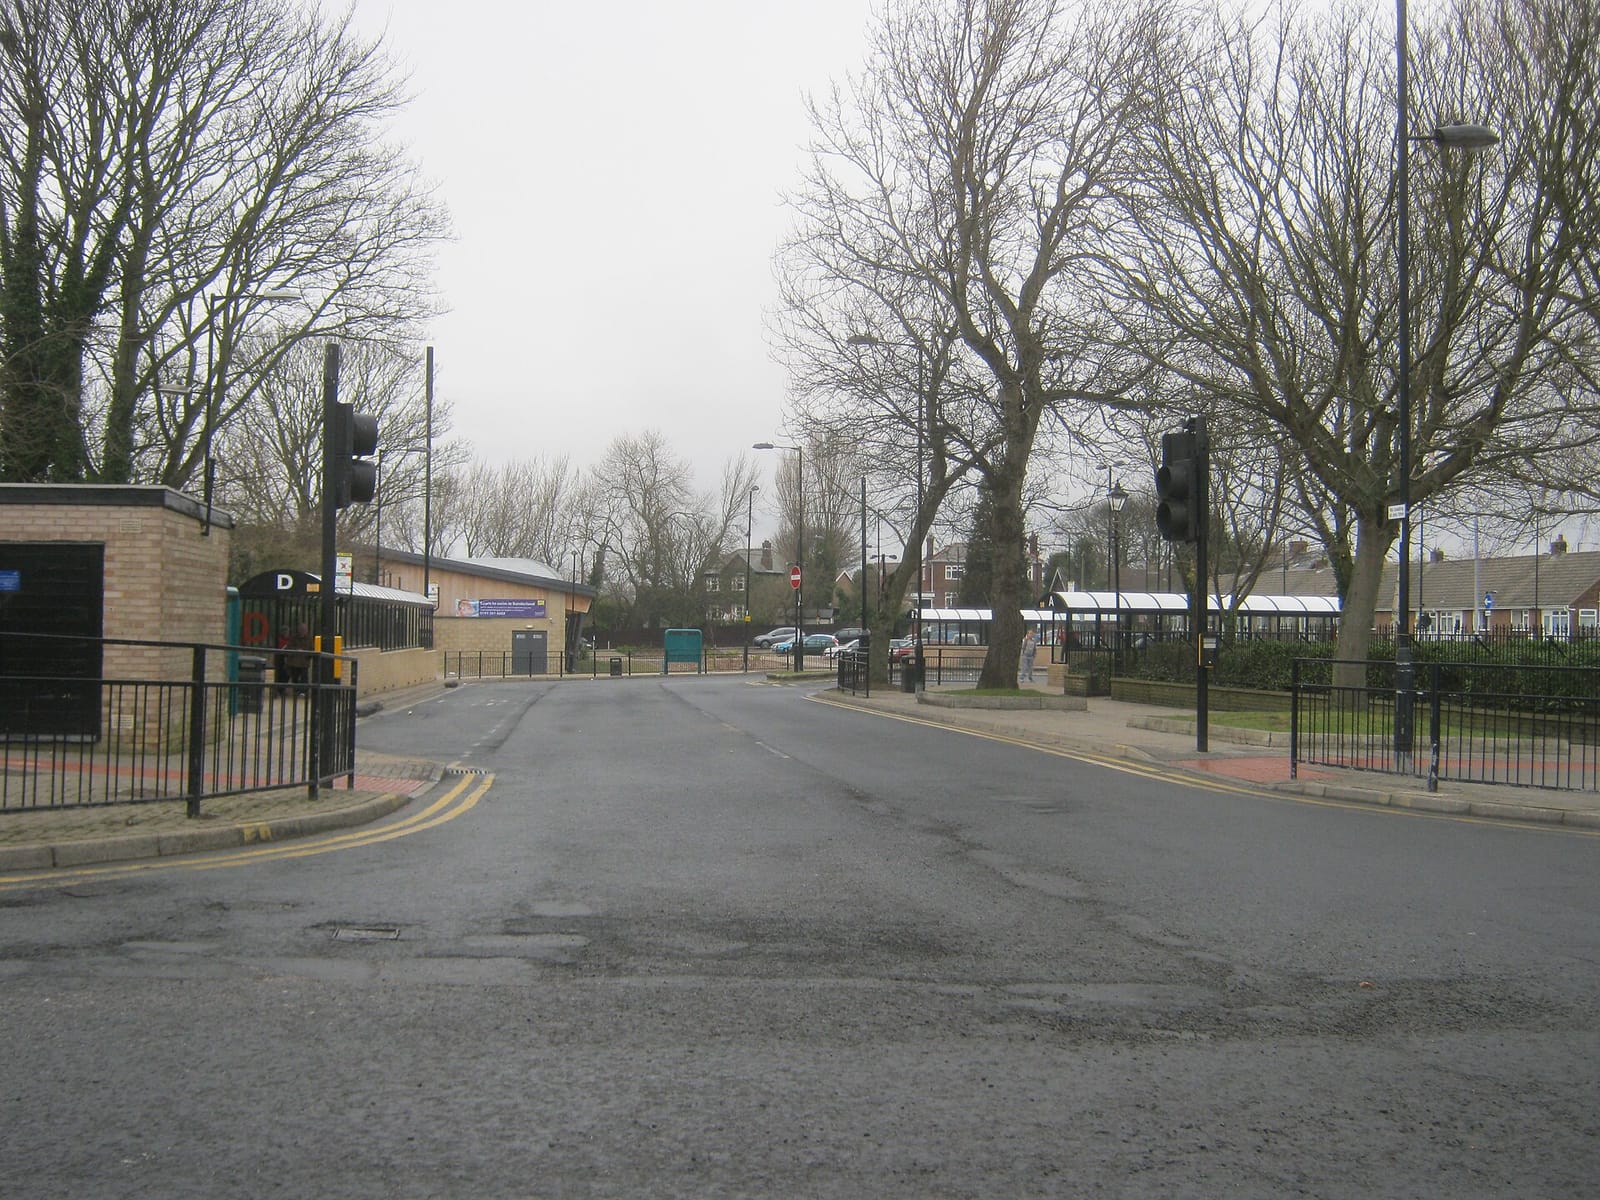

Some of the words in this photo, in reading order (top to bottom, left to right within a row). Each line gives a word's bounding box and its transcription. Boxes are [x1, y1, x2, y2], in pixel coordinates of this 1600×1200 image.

[277, 574, 293, 590] D
[1048, 596, 1055, 607] A
[243, 612, 269, 643] D
